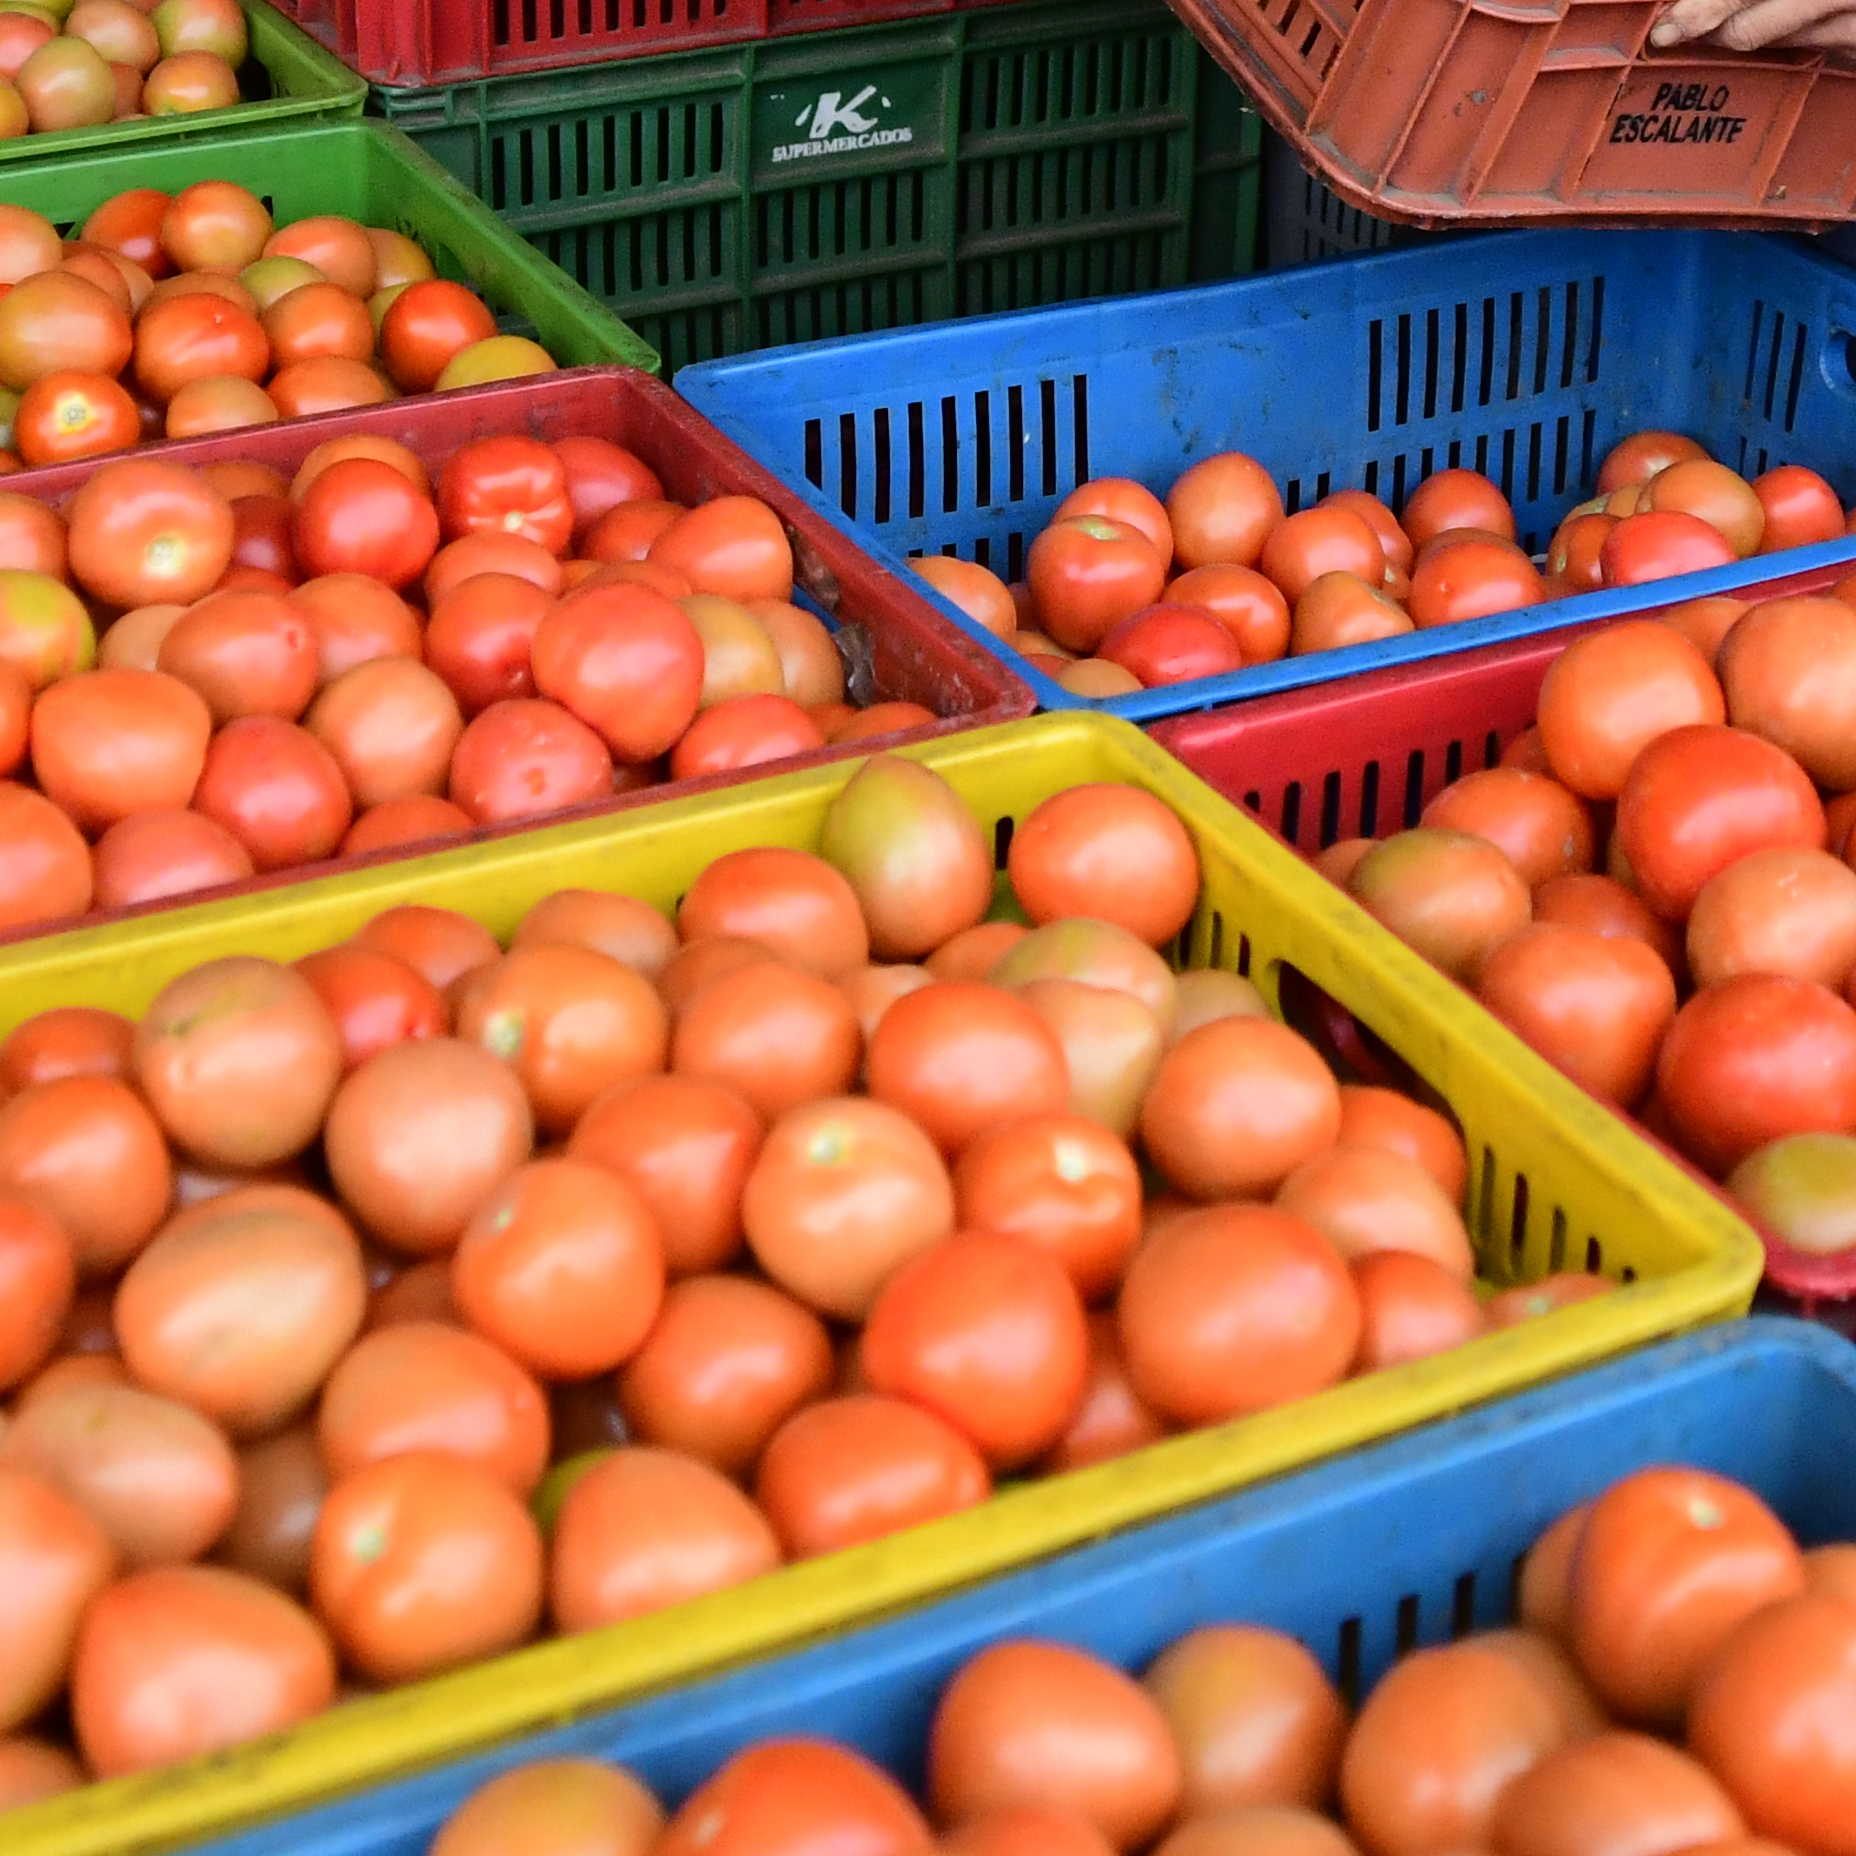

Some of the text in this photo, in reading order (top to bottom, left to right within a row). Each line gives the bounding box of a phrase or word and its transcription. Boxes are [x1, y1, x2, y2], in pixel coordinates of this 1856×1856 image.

[1650, 82, 1731, 112] PABLO
[771, 126, 913, 163] SUPERMERCADOS
[1609, 113, 1747, 145] ESCALANTE
